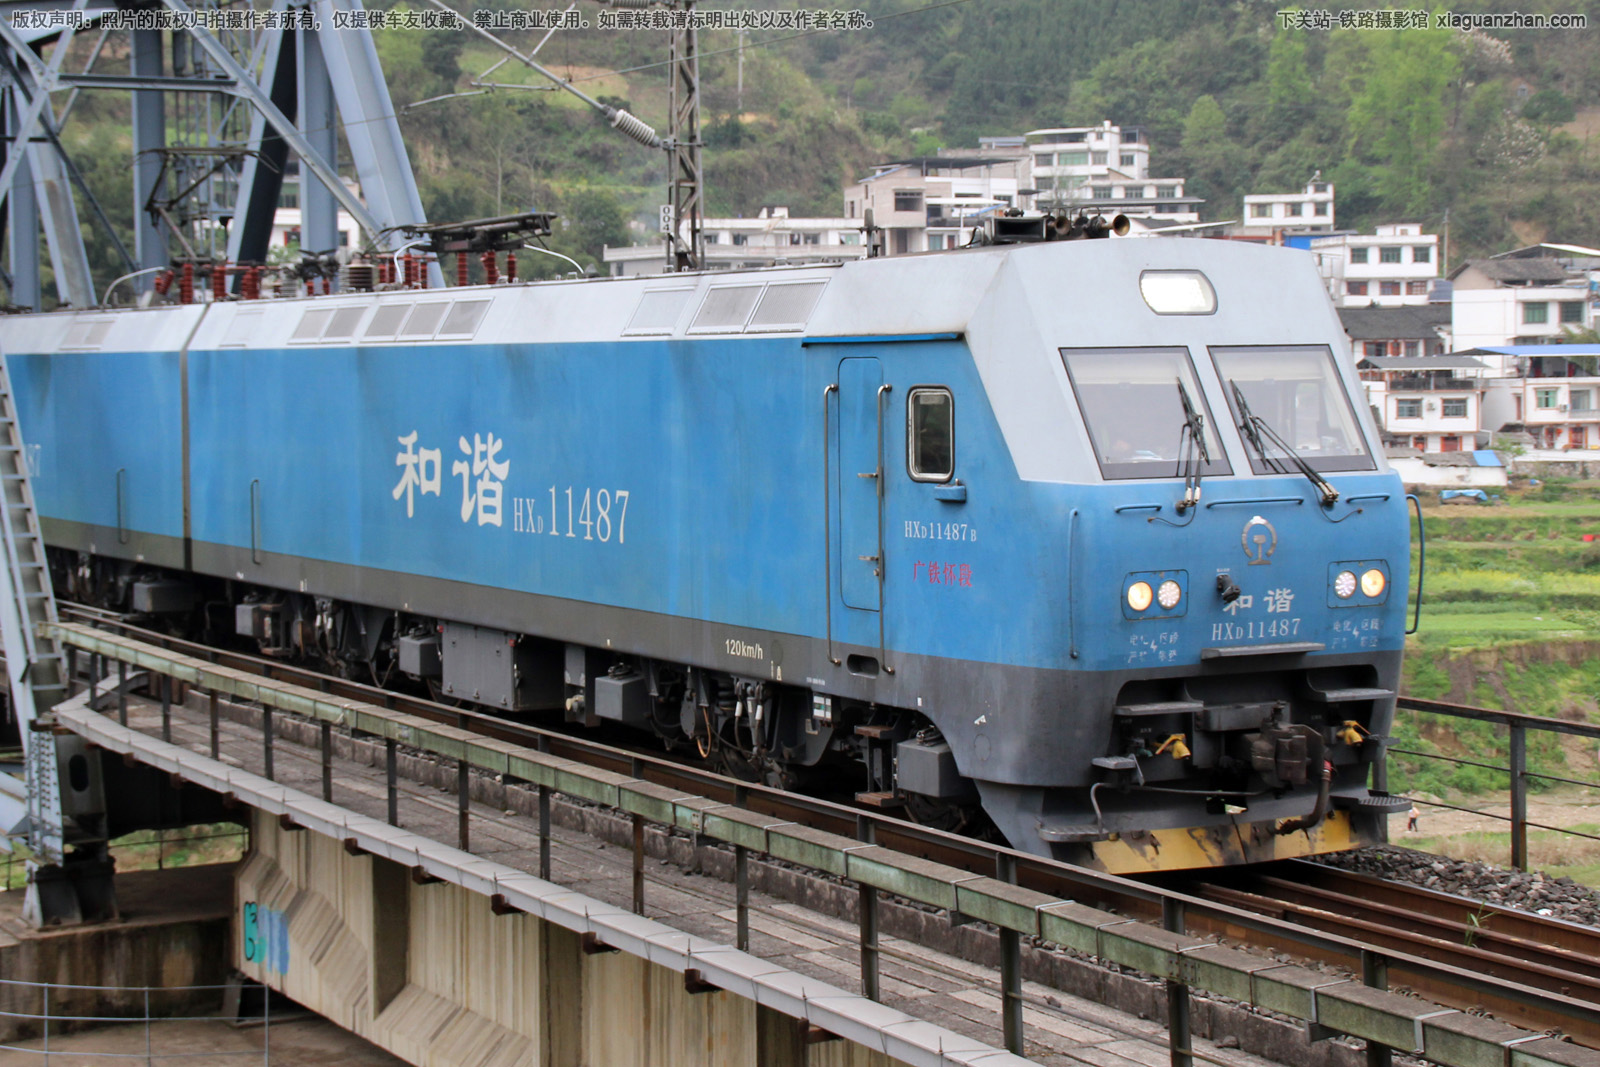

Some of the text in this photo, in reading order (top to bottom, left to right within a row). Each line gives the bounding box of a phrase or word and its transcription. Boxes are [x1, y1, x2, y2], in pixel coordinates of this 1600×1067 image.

[392, 430, 510, 527] 和谐
[913, 560, 973, 587] 广铁怀段
[1222, 588, 1295, 616] 和谐
[1212, 618, 1301, 641] HXD11487
[725, 639, 764, 660] 120km/h
